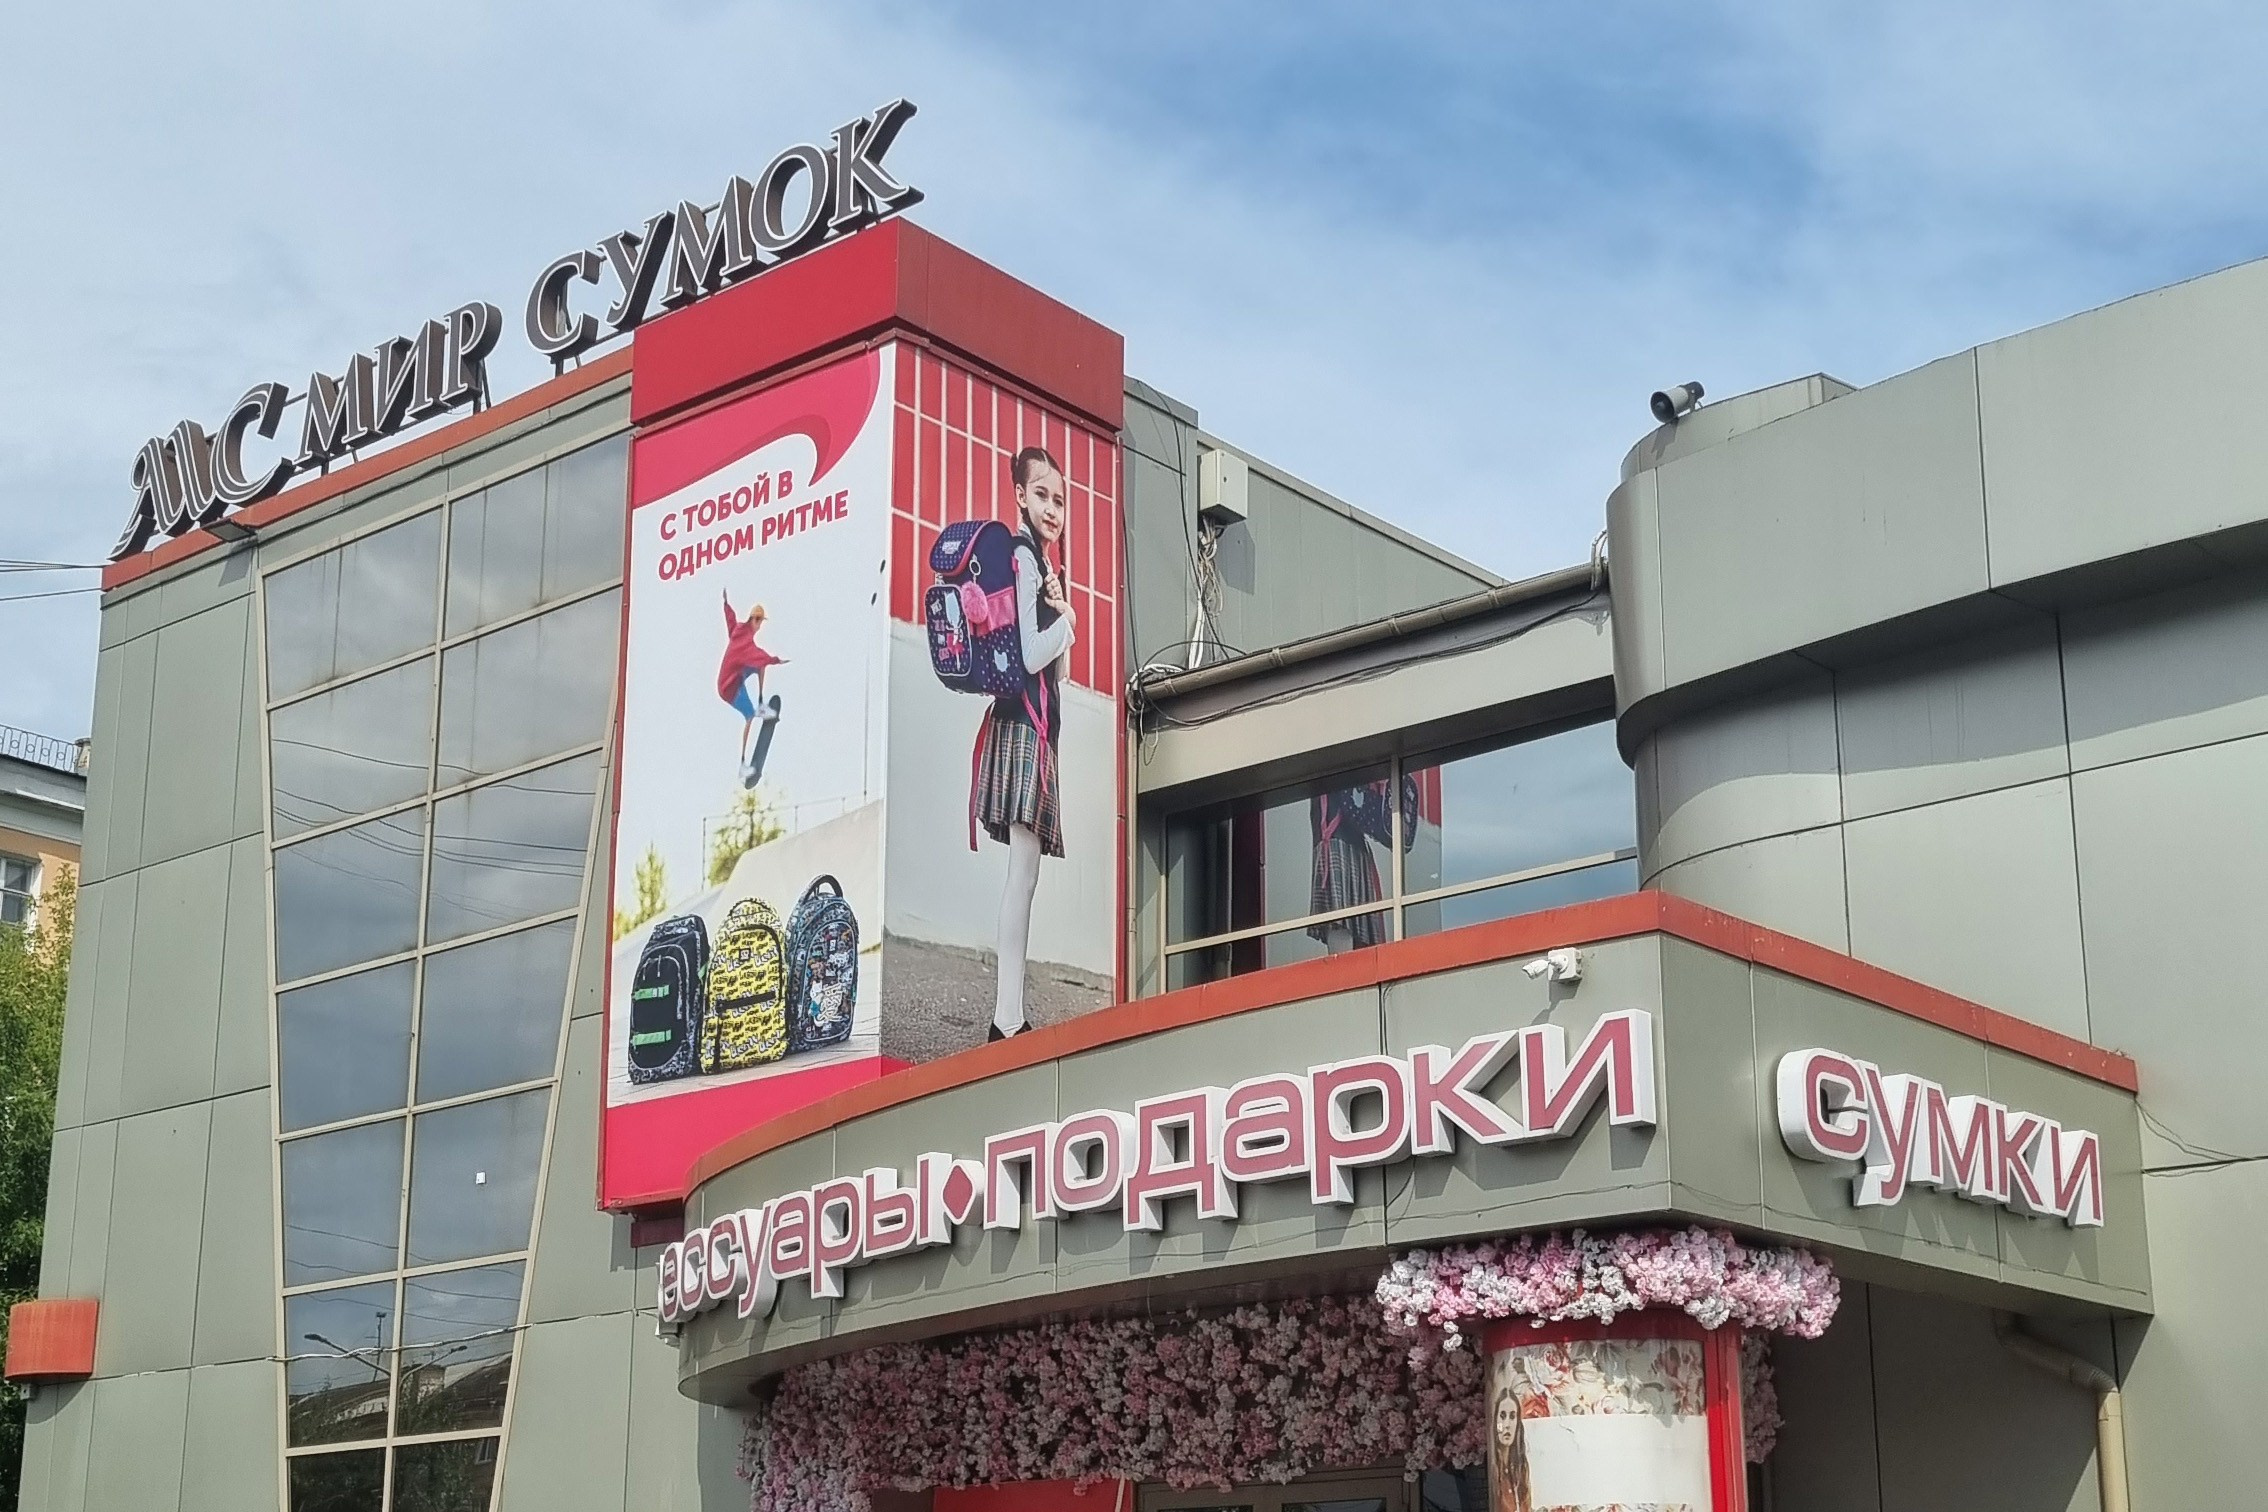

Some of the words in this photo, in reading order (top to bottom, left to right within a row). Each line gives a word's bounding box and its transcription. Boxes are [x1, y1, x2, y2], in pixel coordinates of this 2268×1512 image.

[292, 299, 502, 466] МИР
[525, 97, 925, 358] СУМОК
[658, 523, 754, 581] ОДНОМ
[761, 489, 849, 546] РИТМЕ
[660, 513, 677, 541] С
[682, 471, 771, 533] ТОБОЙ
[777, 470, 793, 500] В
[656, 1152, 952, 1322] ессуары
[983, 1008, 1658, 1232] подарки
[1776, 1047, 2105, 1229] сумки
